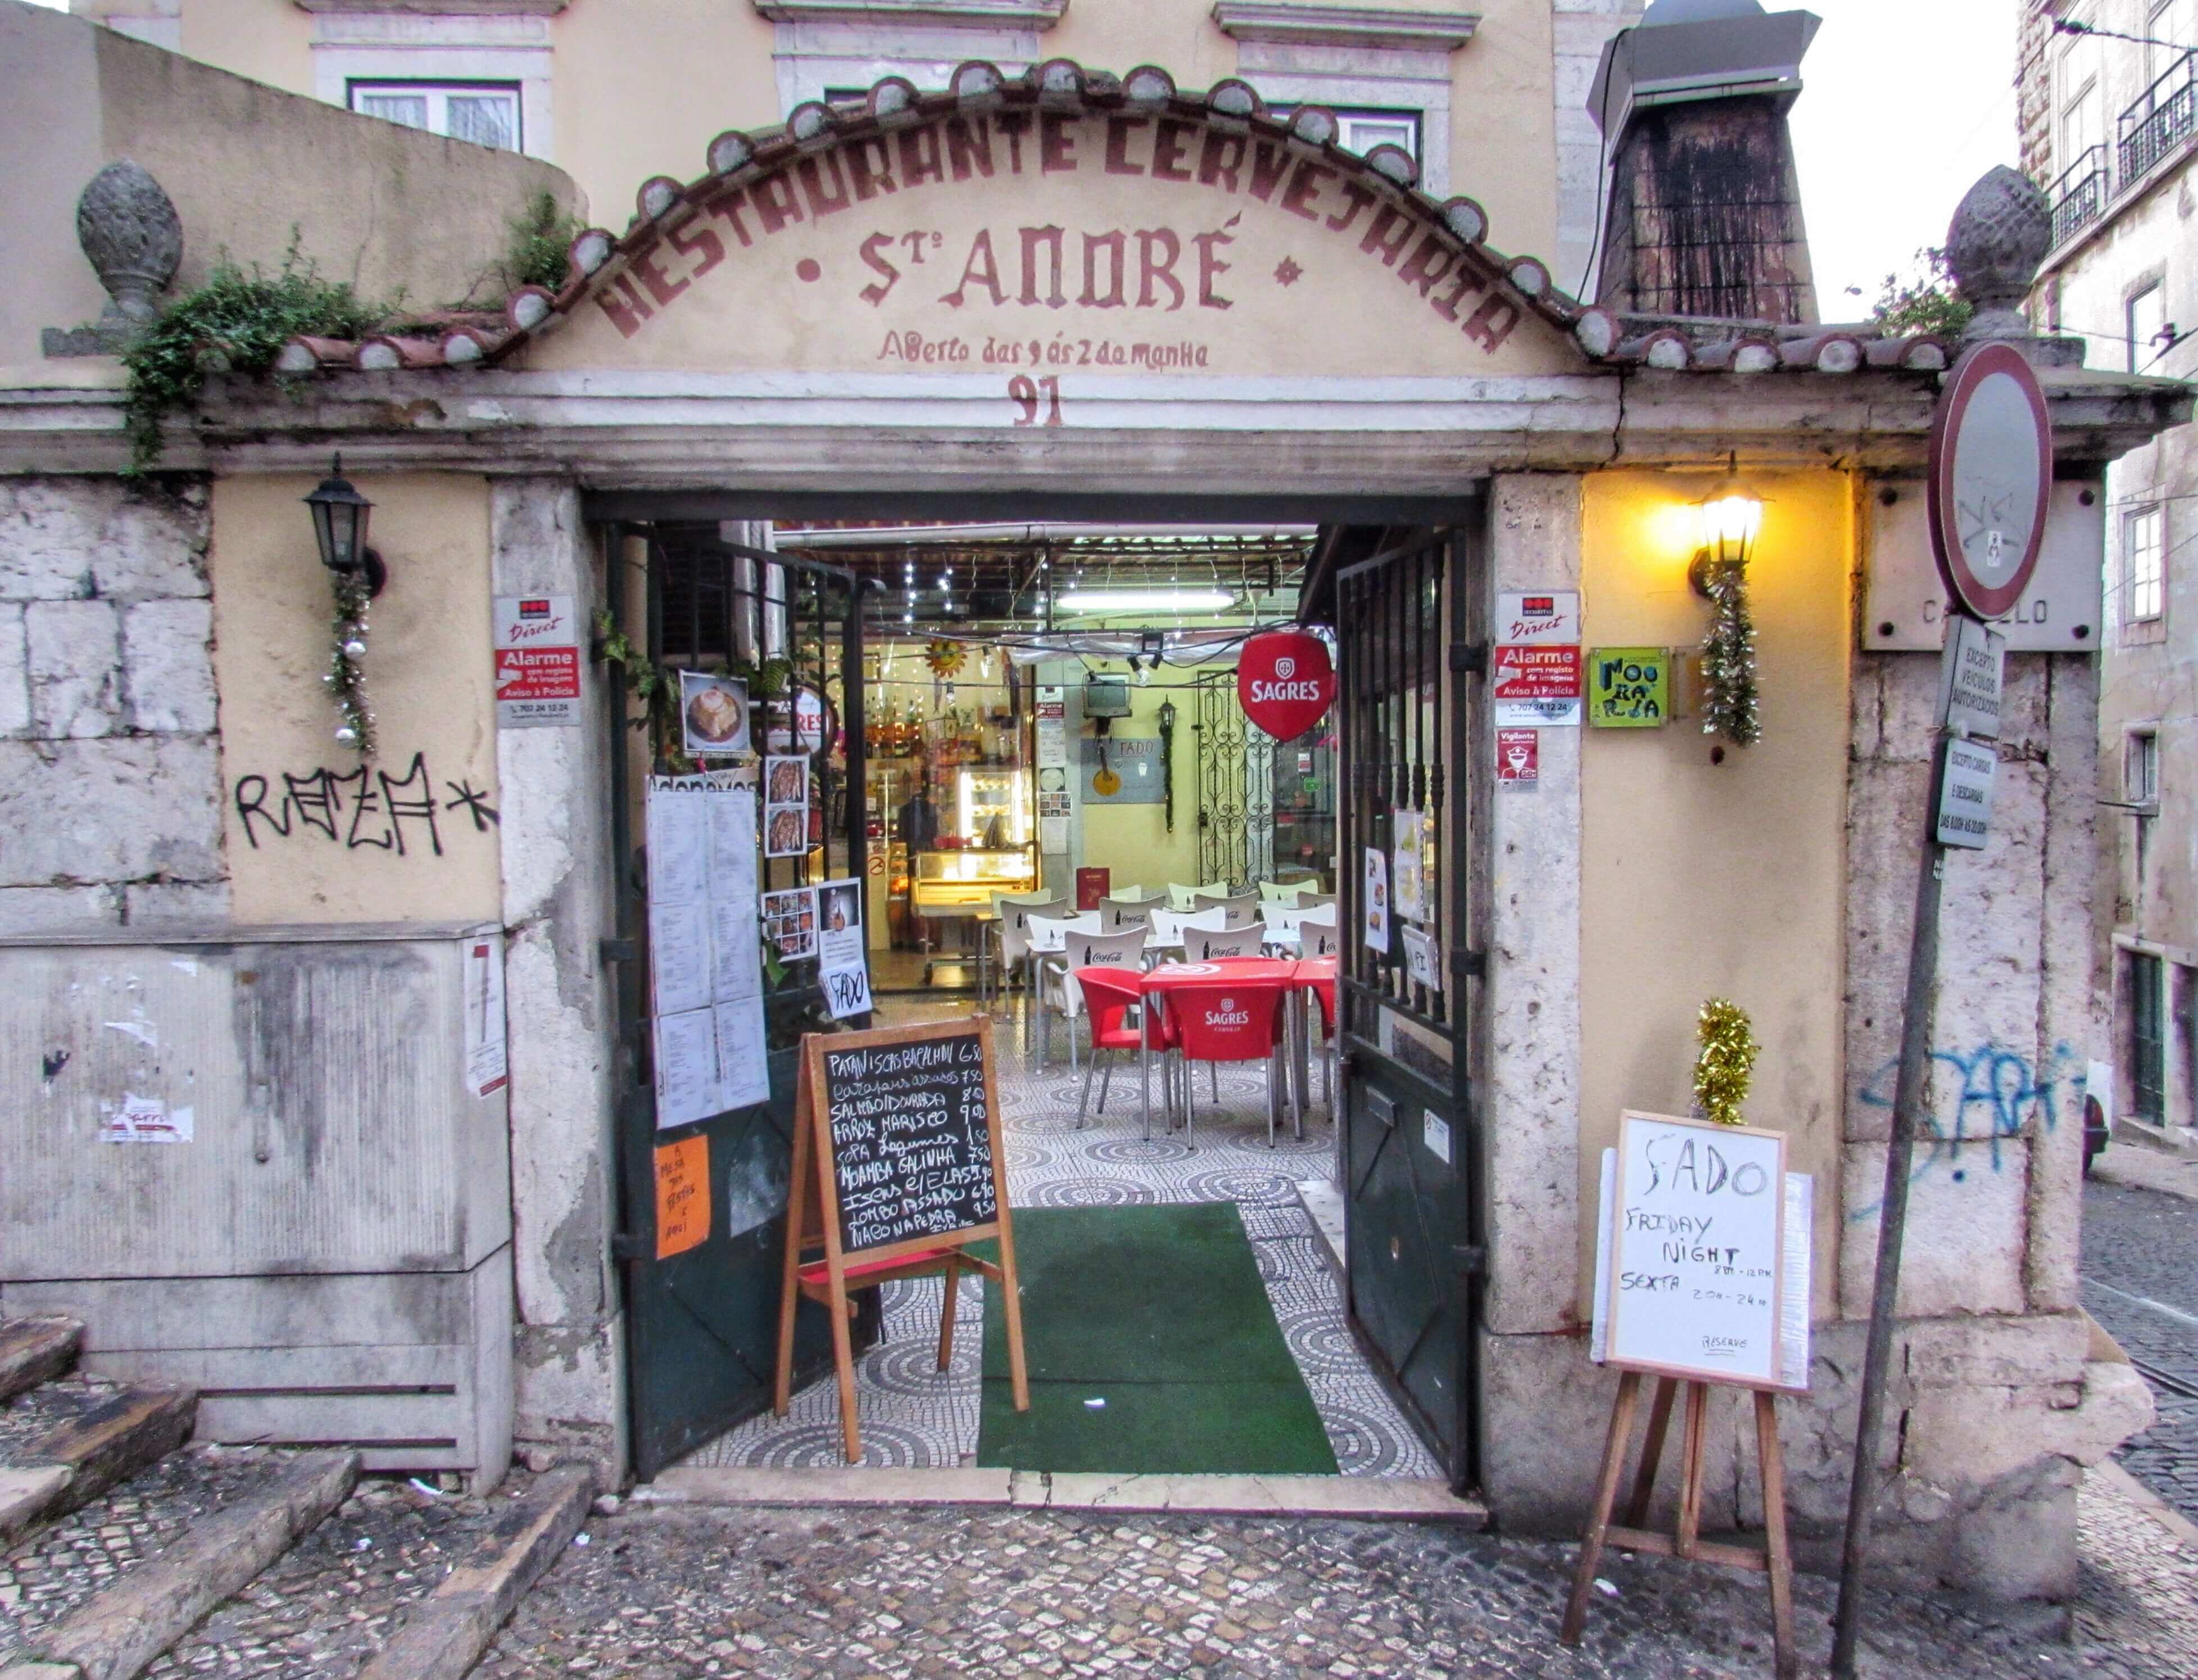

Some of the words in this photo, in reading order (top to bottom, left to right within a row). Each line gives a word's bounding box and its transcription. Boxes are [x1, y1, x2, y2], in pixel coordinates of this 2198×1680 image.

[593, 111, 1077, 339] RESTAURANTE
[1105, 116, 1523, 355] CERVEJARIA
[1076, 339, 1091, 366] 2
[1008, 374, 1062, 427] 91
[509, 617, 564, 642] Direct
[1510, 615, 1569, 640] Direct
[505, 651, 573, 665] Alarme
[1503, 648, 1574, 664] Alarme
[1546, 666, 1574, 674] registo
[505, 688, 532, 697] Aviso
[1251, 680, 1320, 703] SAGRES
[1503, 686, 1530, 695] Aviso
[1533, 686, 1539, 695] à
[1542, 685, 1574, 695] Polícia
[1501, 732, 1535, 742] Vigilante
[830, 971, 864, 1009] FADO
[1205, 1011, 1248, 1026] SAGRES
[841, 1160, 894, 1192] MOAMBA
[848, 1204, 899, 1231] LOMBO
[902, 1188, 966, 1214] ASSADO
[1626, 1208, 1713, 1244] FRIDAY
[1621, 1271, 1680, 1292] SEXTA
